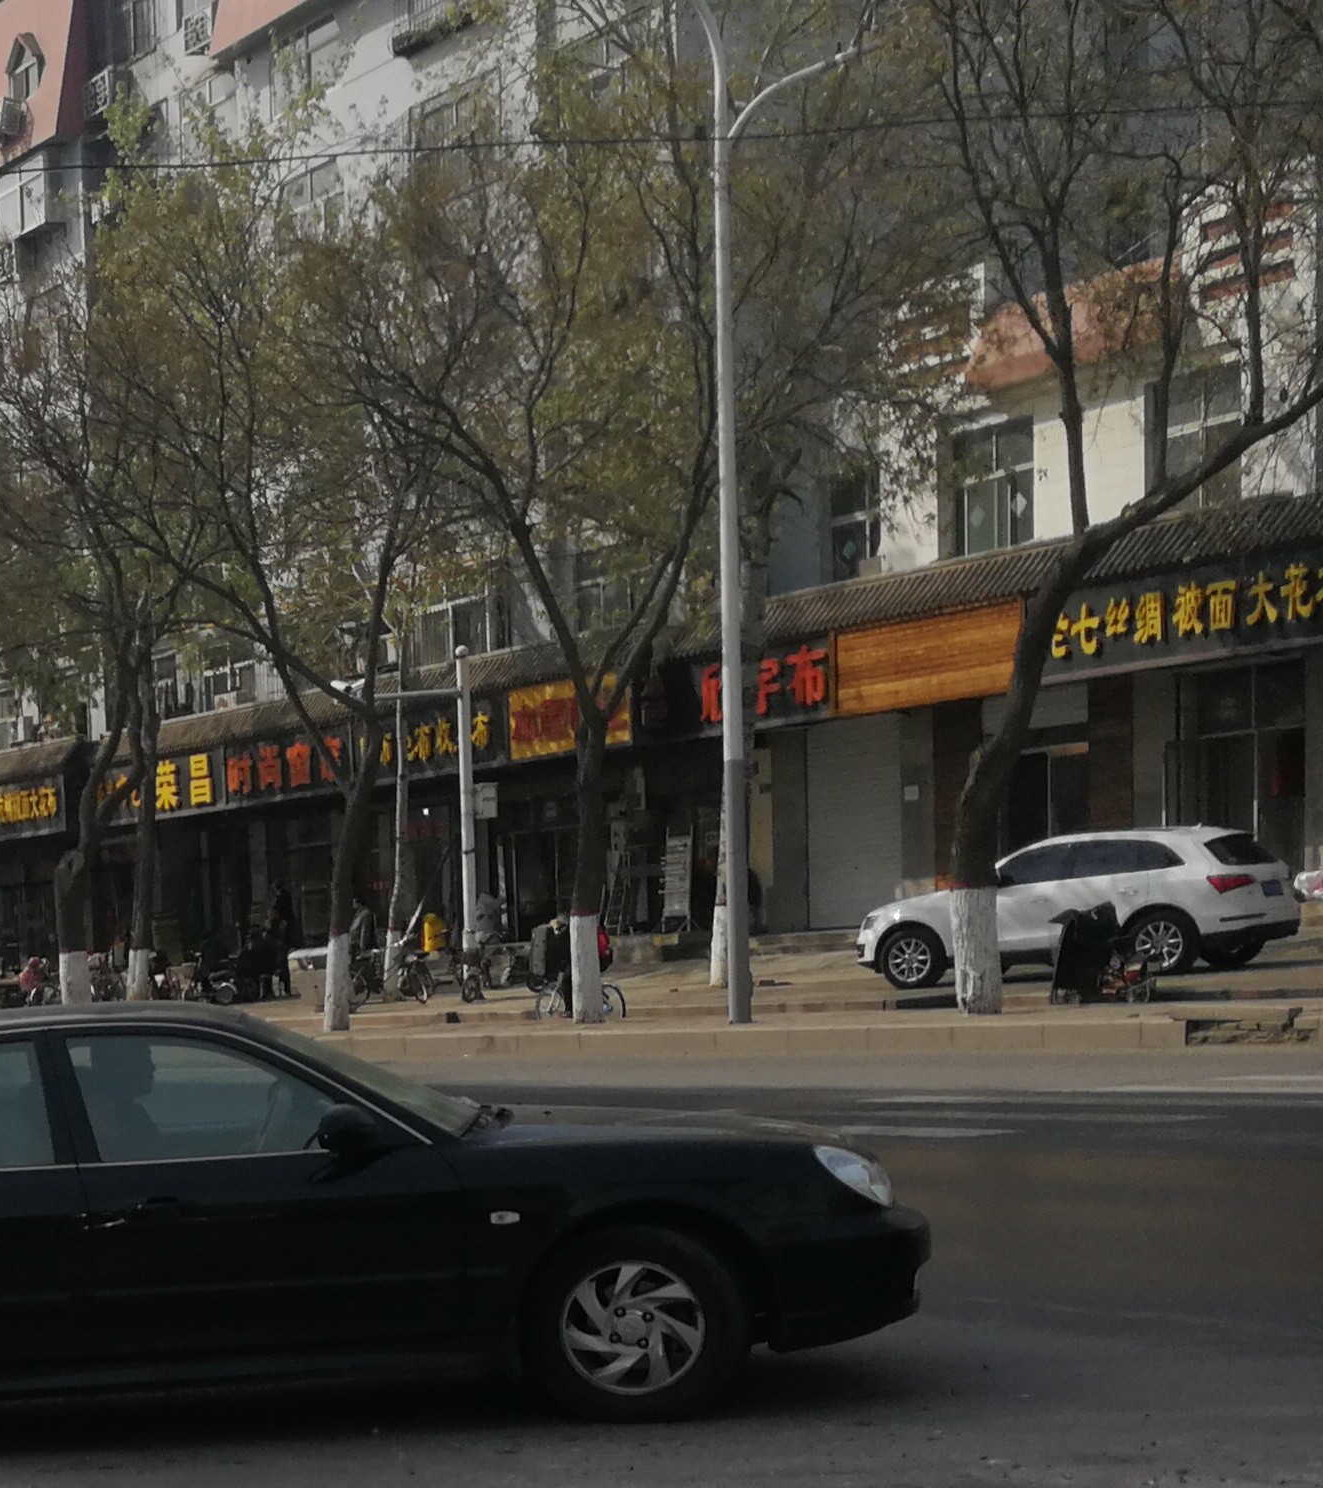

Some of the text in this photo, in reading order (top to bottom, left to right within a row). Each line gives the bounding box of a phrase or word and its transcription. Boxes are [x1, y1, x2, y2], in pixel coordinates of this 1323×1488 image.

[1052, 562, 1323, 658] 七丝绸被面大花
